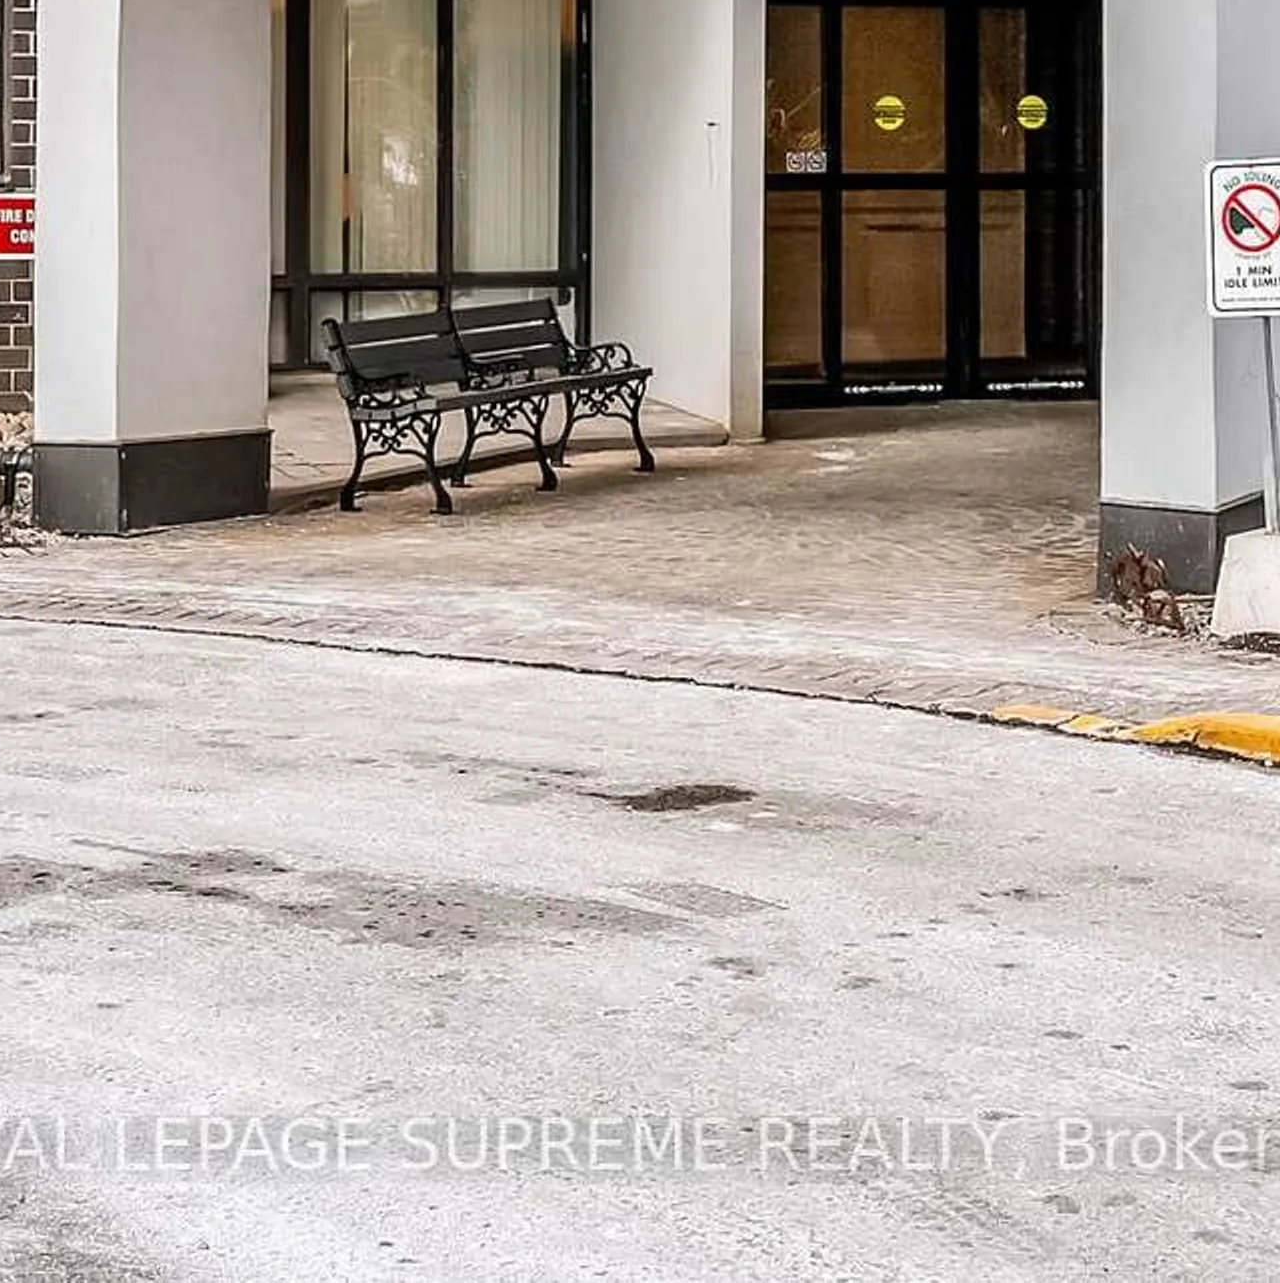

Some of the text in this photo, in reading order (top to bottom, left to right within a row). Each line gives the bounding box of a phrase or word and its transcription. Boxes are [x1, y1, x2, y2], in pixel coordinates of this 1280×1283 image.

[1223, 175, 1241, 192] NO
[1236, 265, 1271, 276] 1 MIN
[1224, 278, 1247, 288] IDLE
